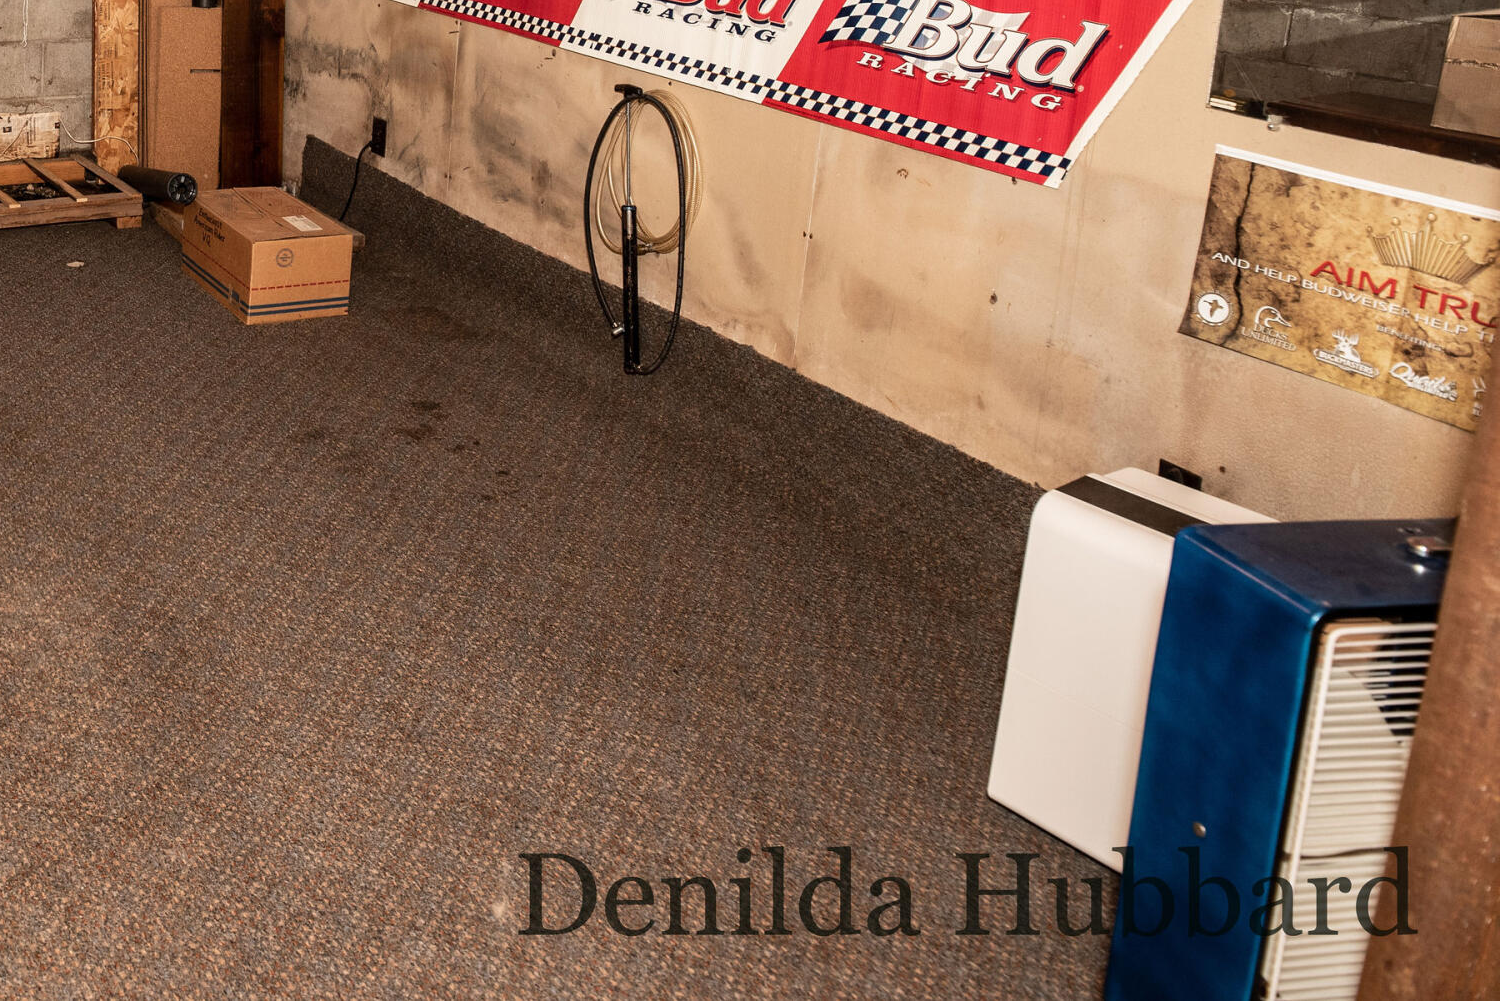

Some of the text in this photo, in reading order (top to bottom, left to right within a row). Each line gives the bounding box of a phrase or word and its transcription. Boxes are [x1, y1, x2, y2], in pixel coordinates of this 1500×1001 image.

[632, 1, 777, 43] RACING
[856, 50, 1065, 112] RACING
[1211, 252, 1251, 270] AND
[1255, 264, 1298, 283] HELP
[1301, 278, 1411, 319] BUDWEISER
[1414, 312, 1469, 335] HELP
[1310, 260, 1398, 300] AIM
[1241, 326, 1297, 352] UNLIMITED
